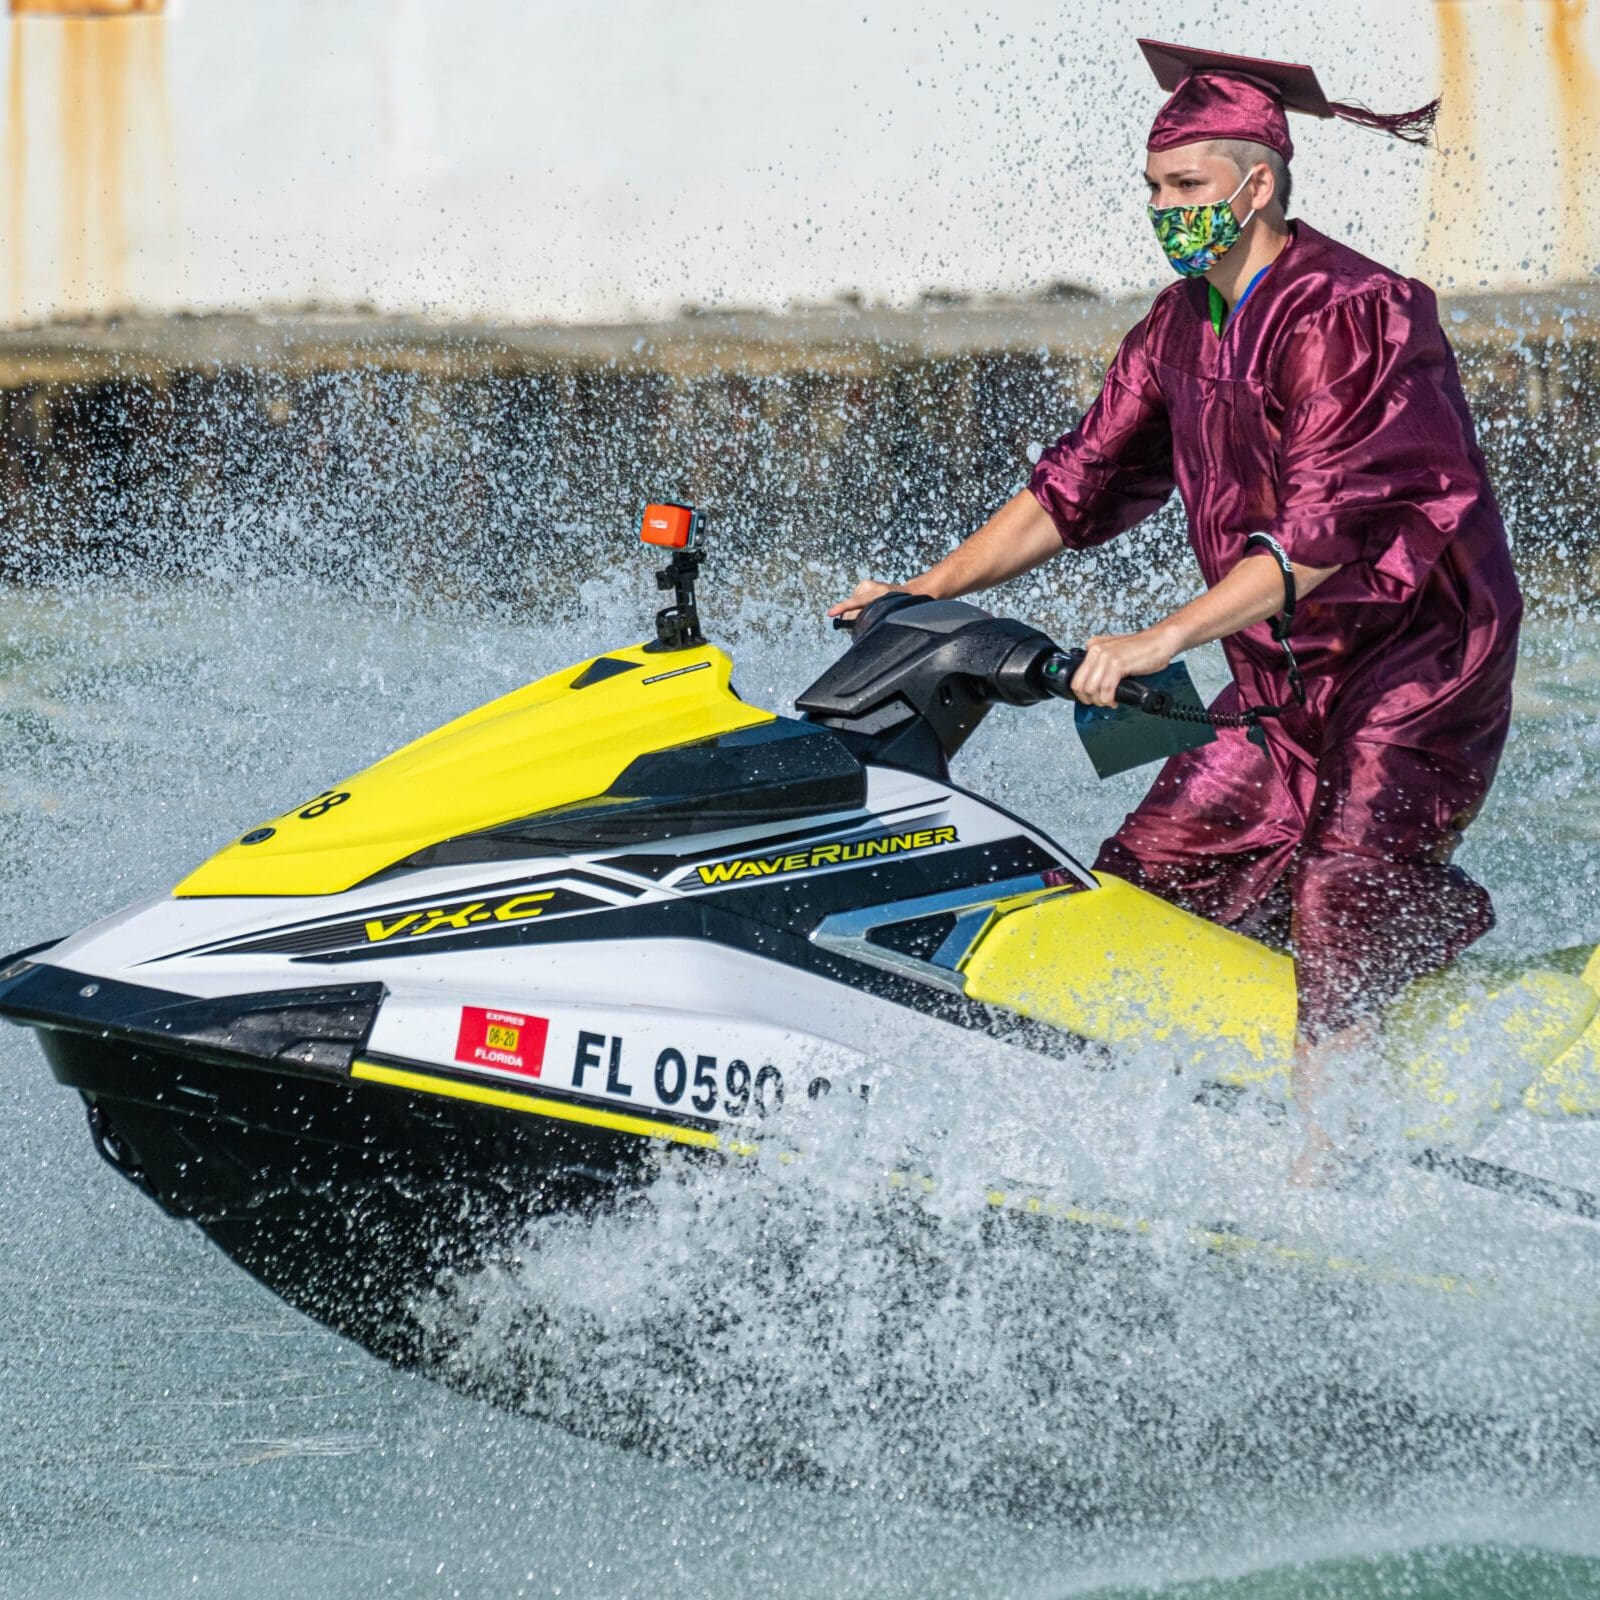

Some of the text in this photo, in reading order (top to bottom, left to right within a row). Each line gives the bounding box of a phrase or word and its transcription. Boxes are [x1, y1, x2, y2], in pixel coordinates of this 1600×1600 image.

[697, 826, 956, 885] WAVERUNNER
[365, 891, 556, 942] VX-C
[485, 1011, 525, 1027] EXPIRES
[488, 1027, 516, 1048] 06-20
[474, 1047, 524, 1068] FLORIDA
[571, 1030, 632, 1097] FL
